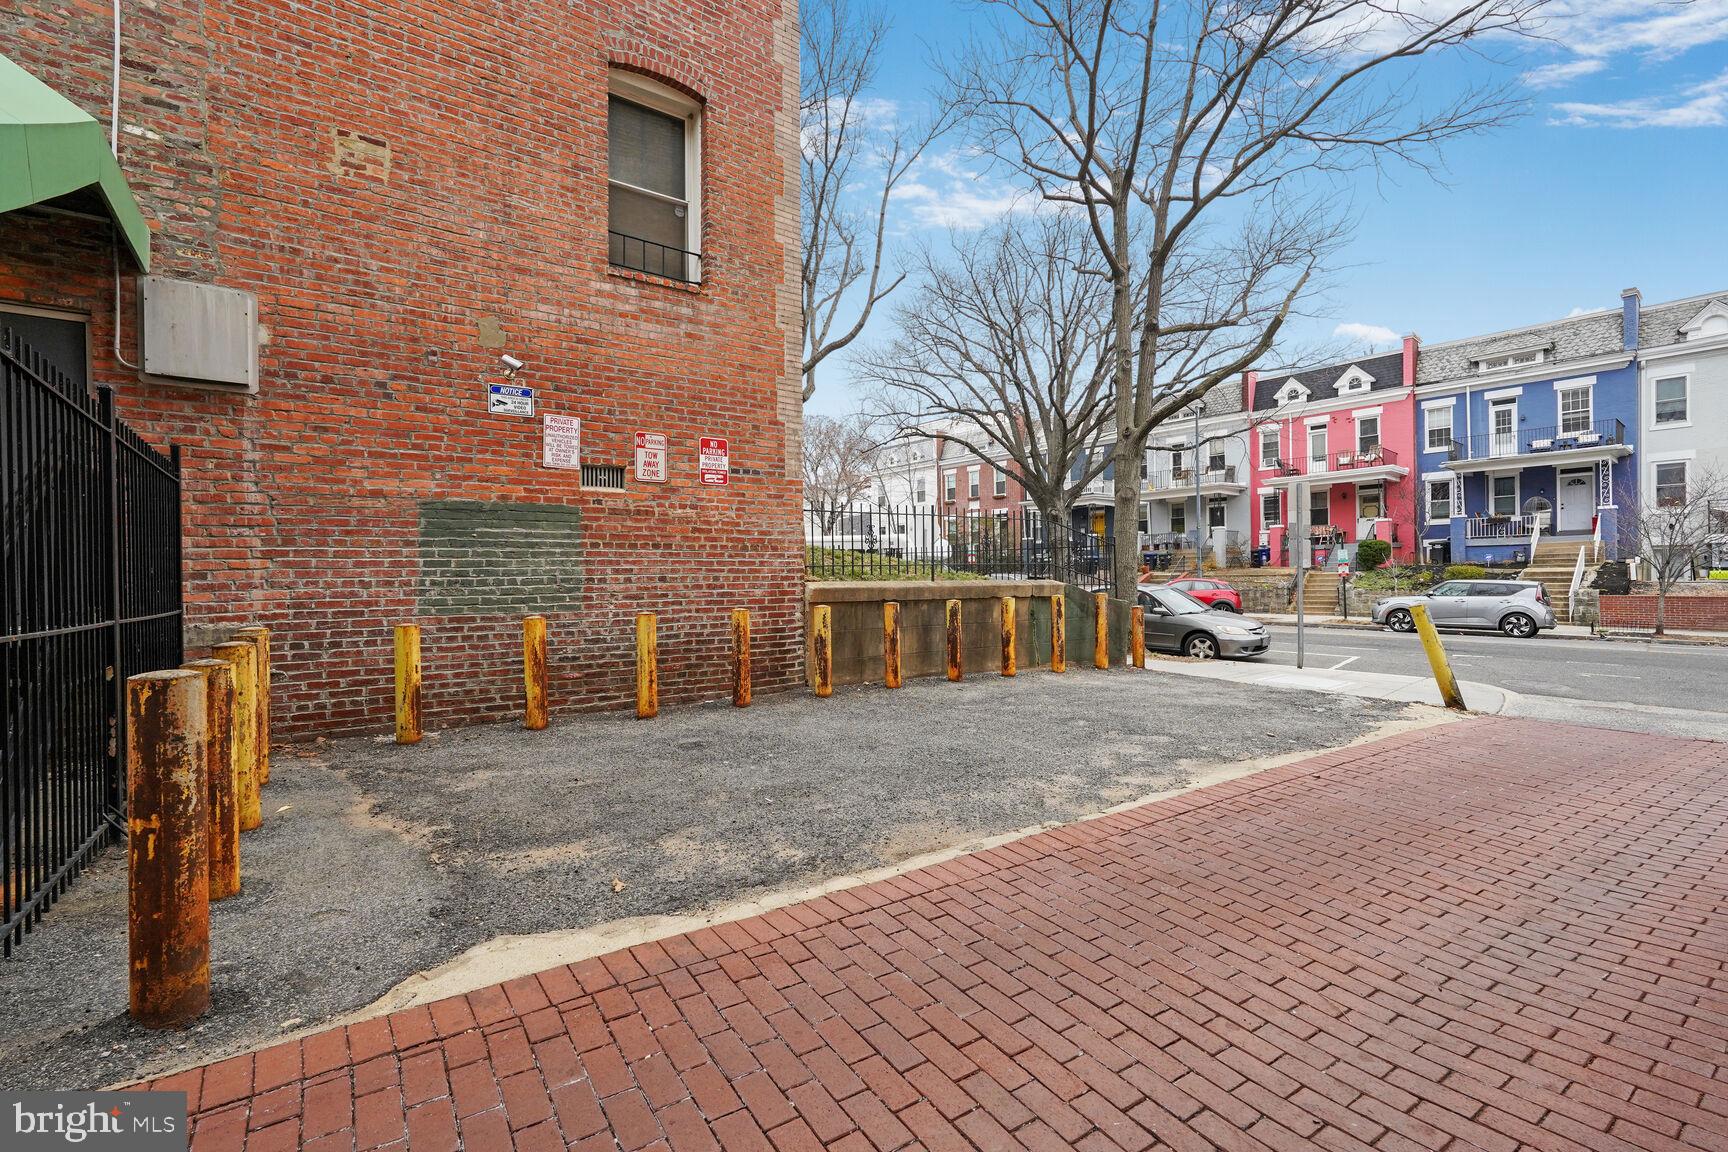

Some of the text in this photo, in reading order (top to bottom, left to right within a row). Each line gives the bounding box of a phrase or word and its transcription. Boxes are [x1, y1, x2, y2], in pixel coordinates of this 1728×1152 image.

[500, 387, 523, 396] NOTICE
[550, 417, 574, 426] PRIVATE
[545, 424, 578, 434] PROPERTY
[636, 436, 645, 446] NO
[645, 451, 658, 460] TOW
[702, 448, 726, 456] PARKING
[643, 460, 660, 468] AWAY
[642, 469, 660, 477] ZONE
